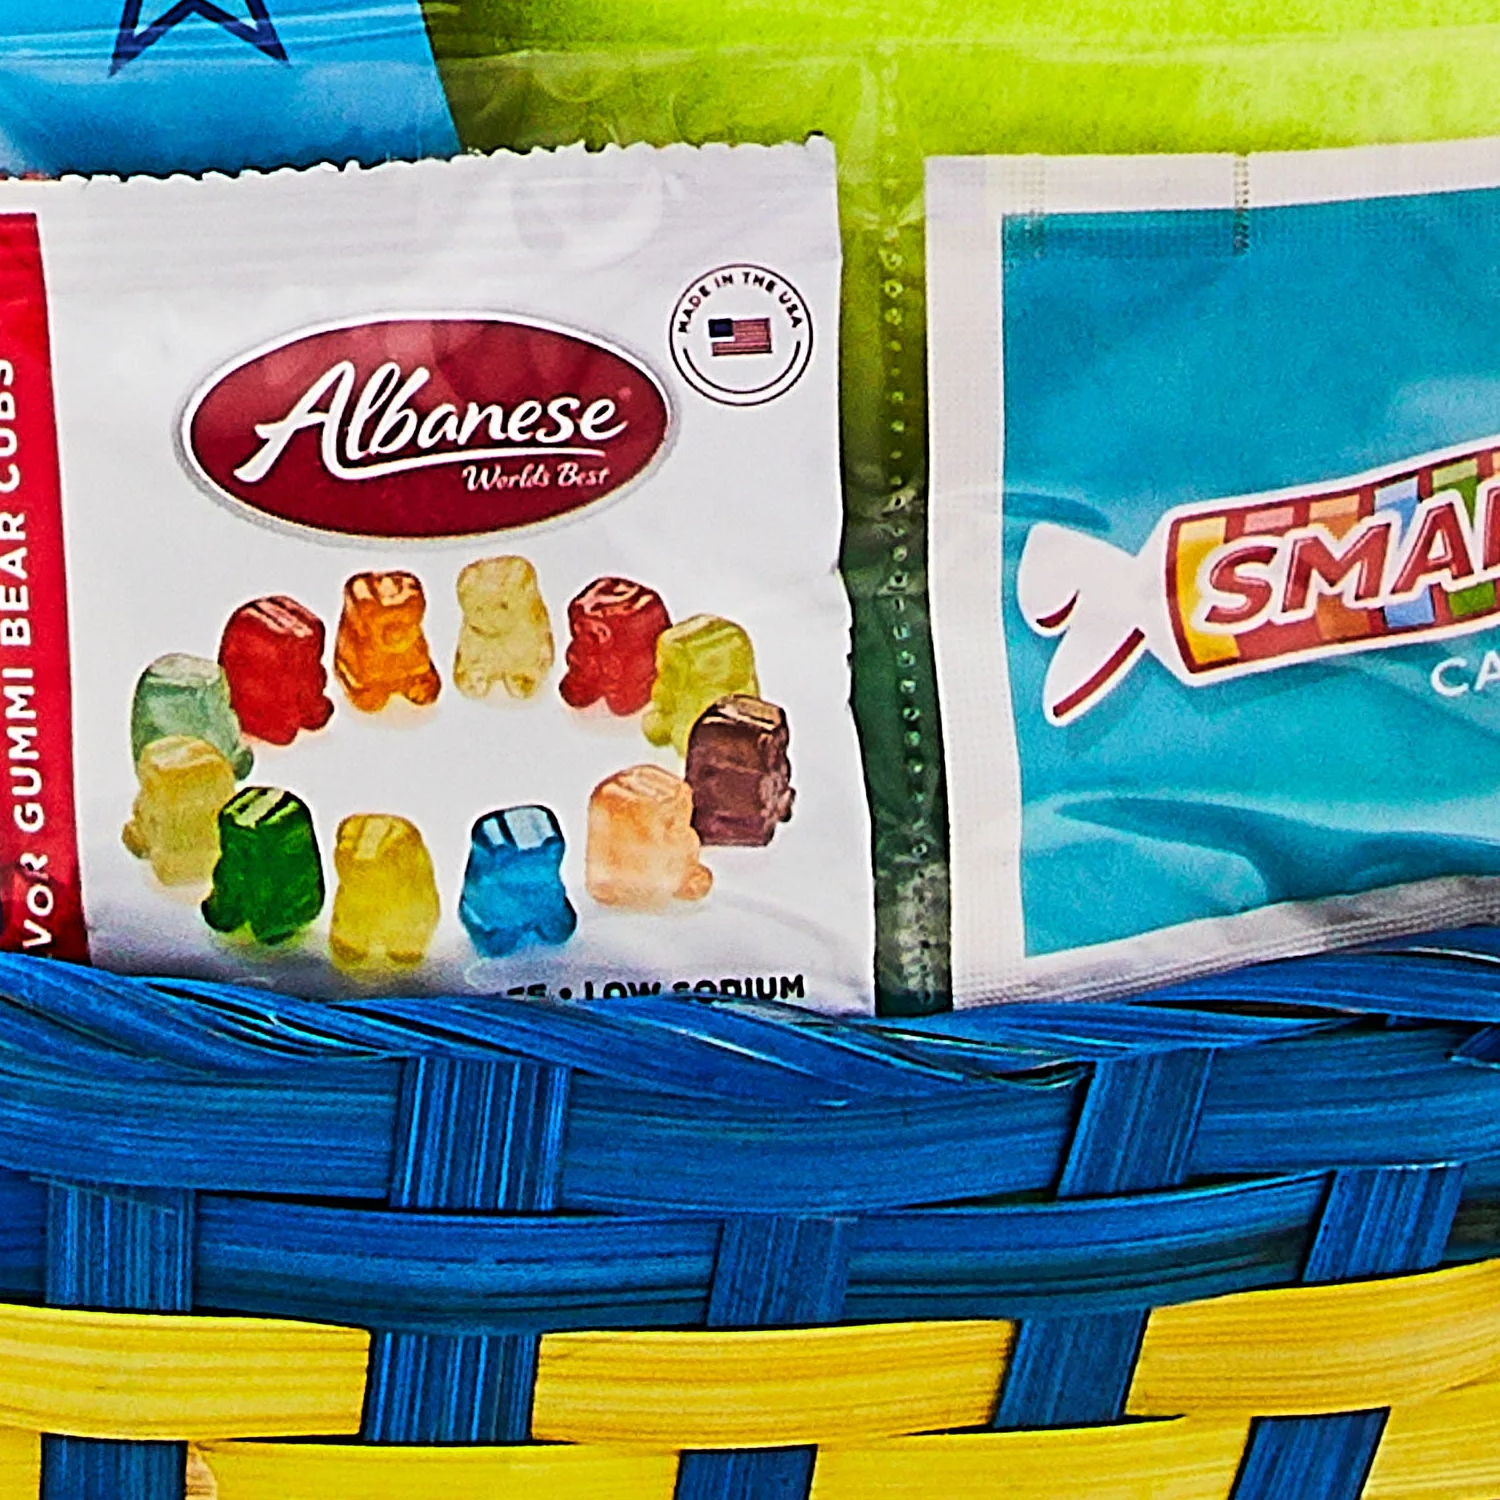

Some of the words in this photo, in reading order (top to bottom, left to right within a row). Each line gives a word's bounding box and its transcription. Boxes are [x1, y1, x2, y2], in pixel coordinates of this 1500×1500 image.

[678, 285, 711, 333] MADE
[714, 274, 733, 288] IN
[742, 272, 777, 294] THE
[778, 291, 803, 328] USA
[234, 360, 631, 483] Albanese
[1, 667, 45, 833] GUMMI
[20, 852, 55, 950] VOR
